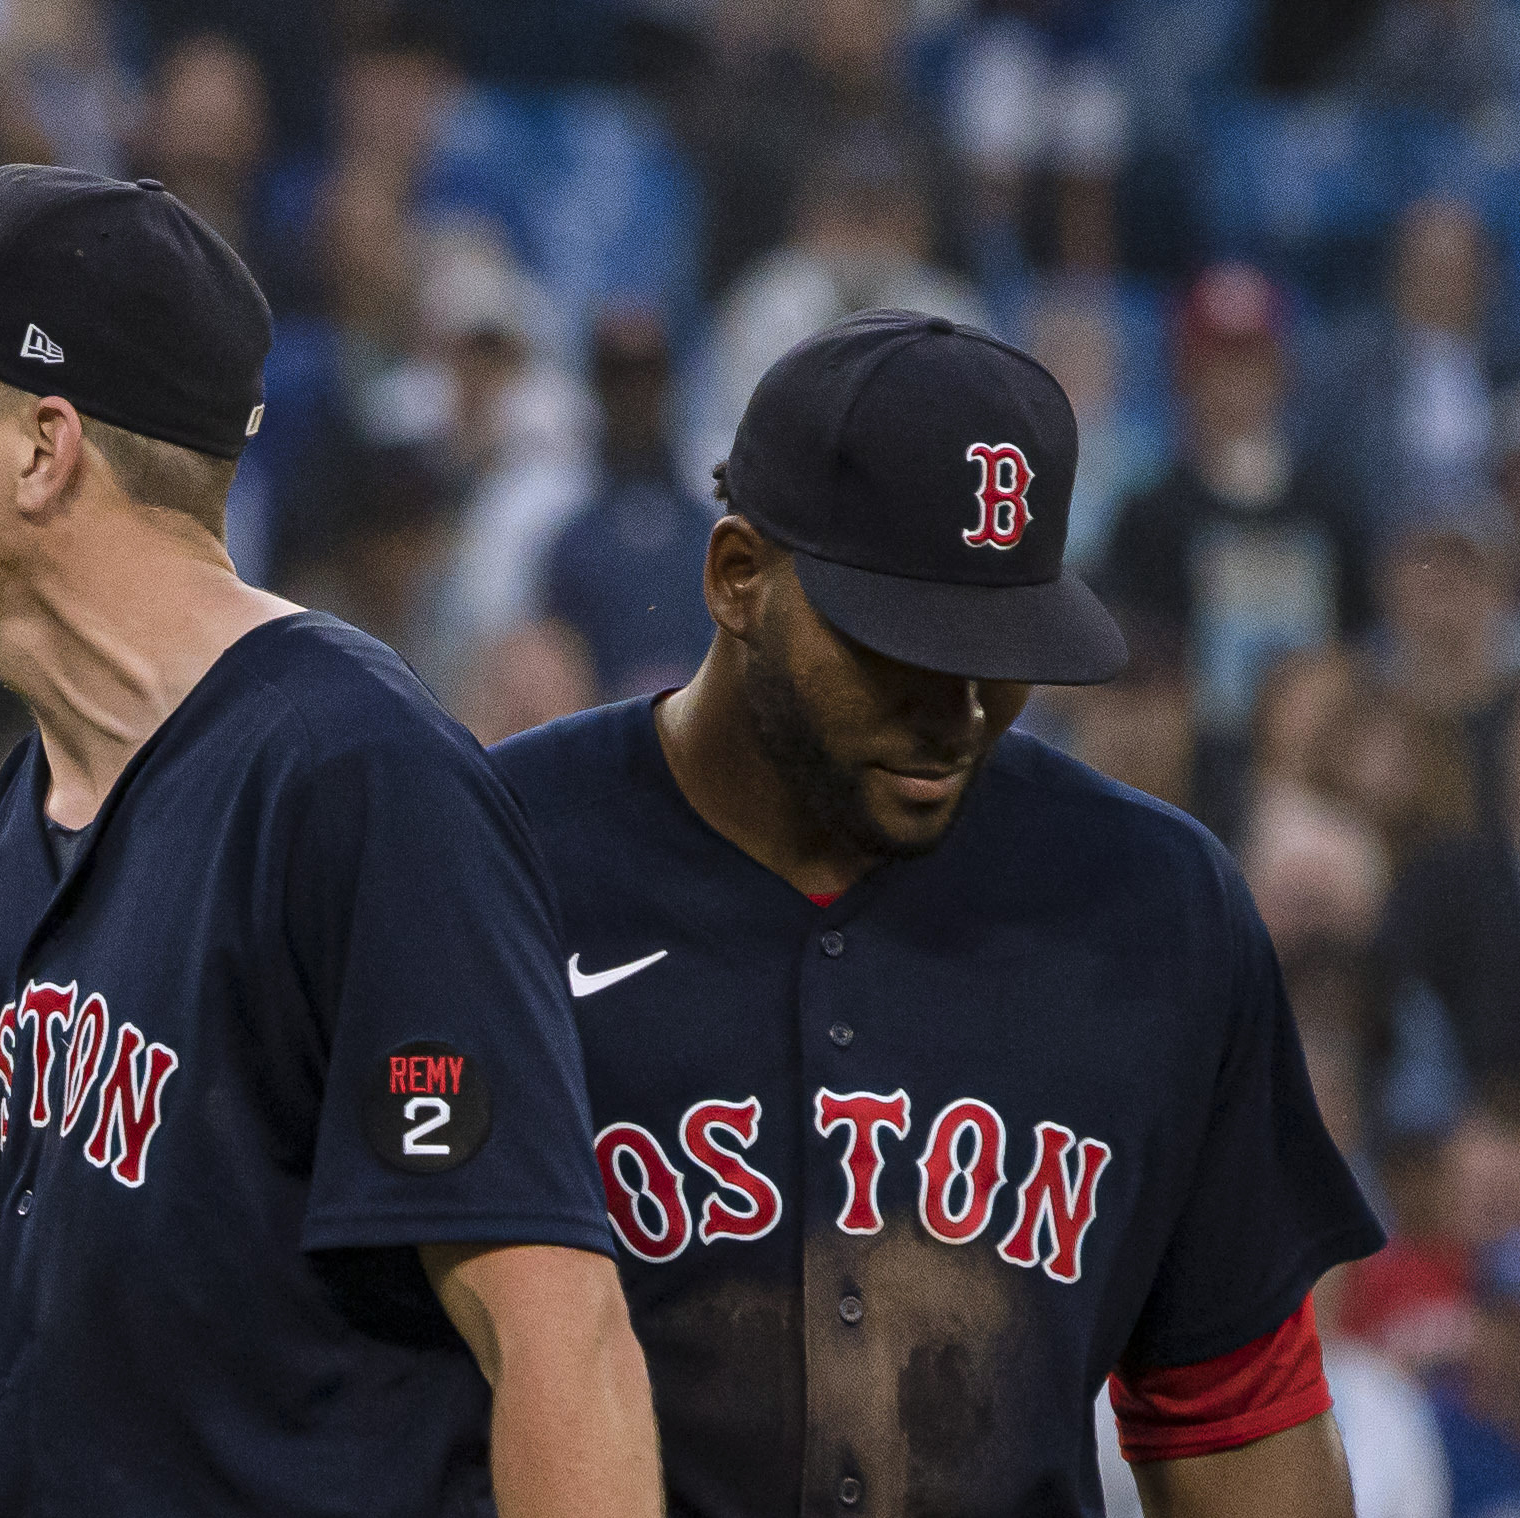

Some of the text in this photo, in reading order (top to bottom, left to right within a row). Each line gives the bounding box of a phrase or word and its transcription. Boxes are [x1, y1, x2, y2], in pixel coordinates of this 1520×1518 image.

[961, 442, 1036, 551] B
[389, 1055, 464, 1095] REMY
[403, 1096, 451, 1156] 2
[593, 1085, 1112, 1285] OSTON
